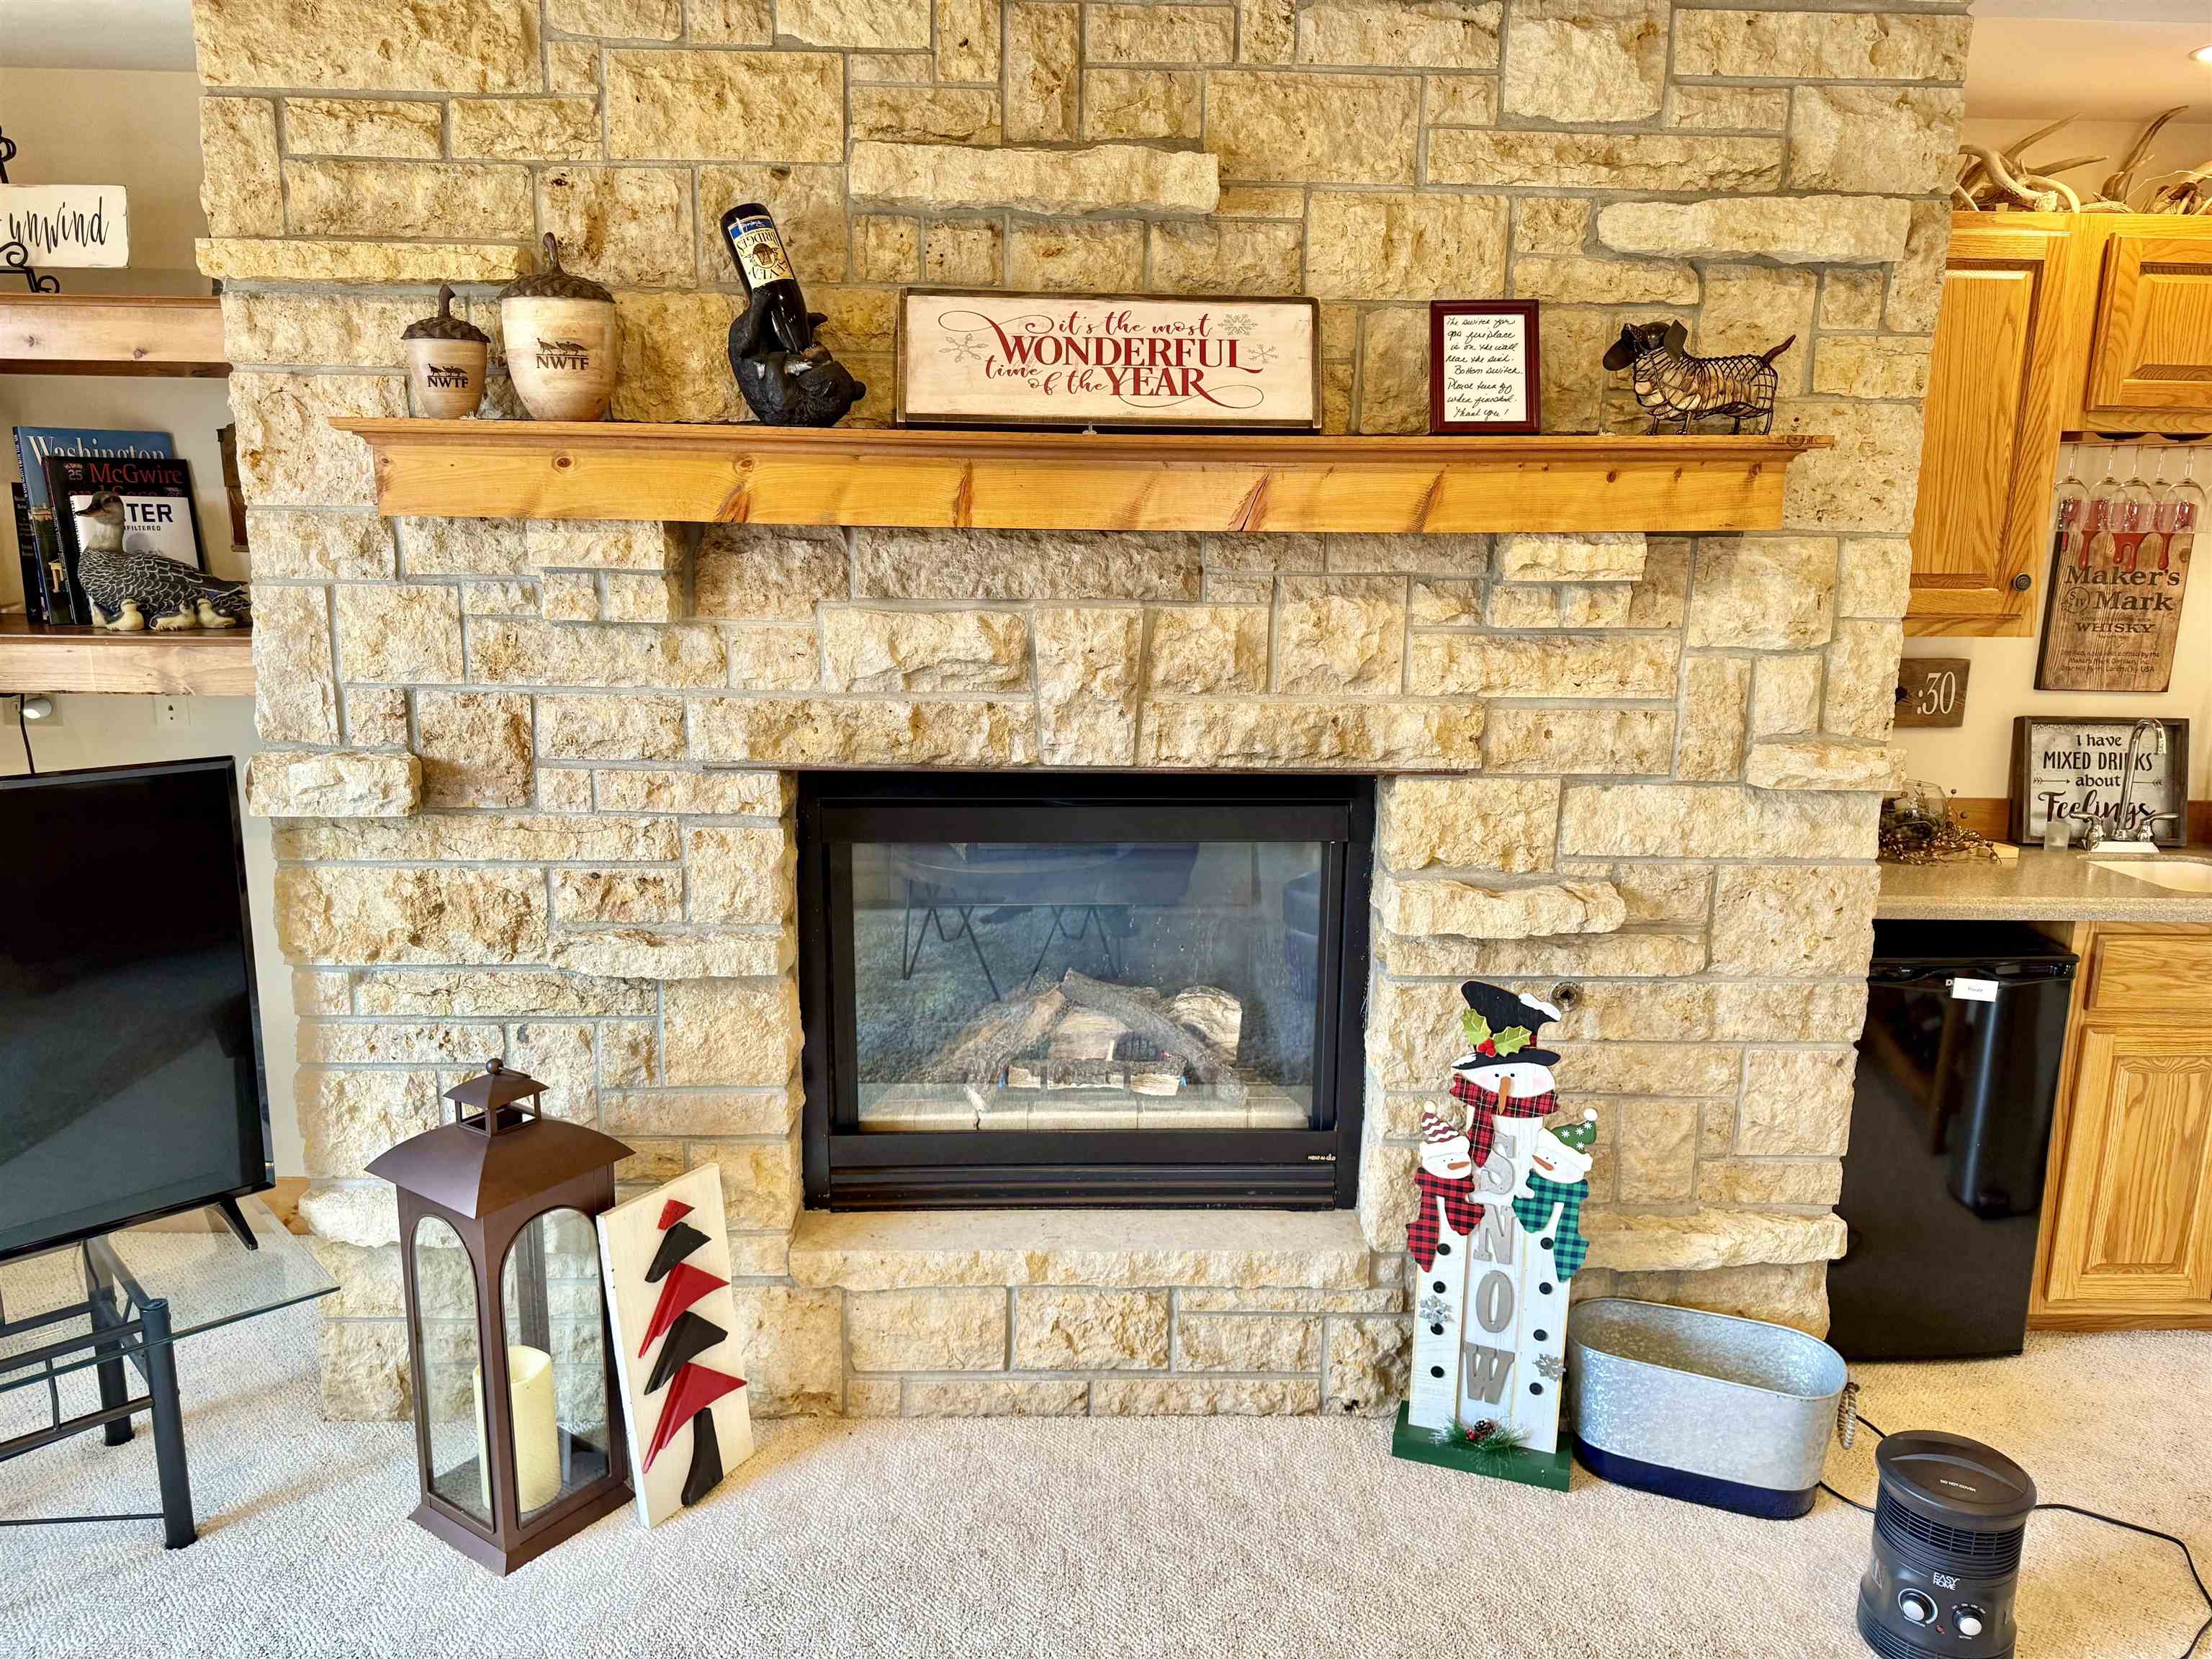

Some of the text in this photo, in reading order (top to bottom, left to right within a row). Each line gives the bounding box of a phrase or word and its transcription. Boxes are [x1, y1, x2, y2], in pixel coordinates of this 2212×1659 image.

[1059, 310, 1213, 337] it's the most
[1465, 330, 1516, 344] fireplace
[981, 317, 1263, 373] WONDERFUL
[536, 356, 589, 370] NWTF
[985, 355, 1043, 379] time
[1455, 365, 1483, 374] Bottom
[427, 375, 468, 389] NWTF
[1028, 367, 1224, 407] of the YEAR
[1447, 377, 1473, 390] Please
[68, 469, 83, 481] 25
[87, 463, 184, 484] McGwire
[2064, 565, 2180, 586] Maker's
[2092, 590, 2174, 611] Mark
[2074, 622, 2157, 634] WHISKY
[1917, 671, 1956, 715] :30
[2076, 734, 2123, 746] I have
[2043, 751, 2091, 770] MIXED
[2075, 774, 2121, 787] about
[1463, 1132, 1517, 1406] SNOW
[1933, 1572, 1959, 1585] EASY
[1933, 1578, 1956, 1591] HOME
